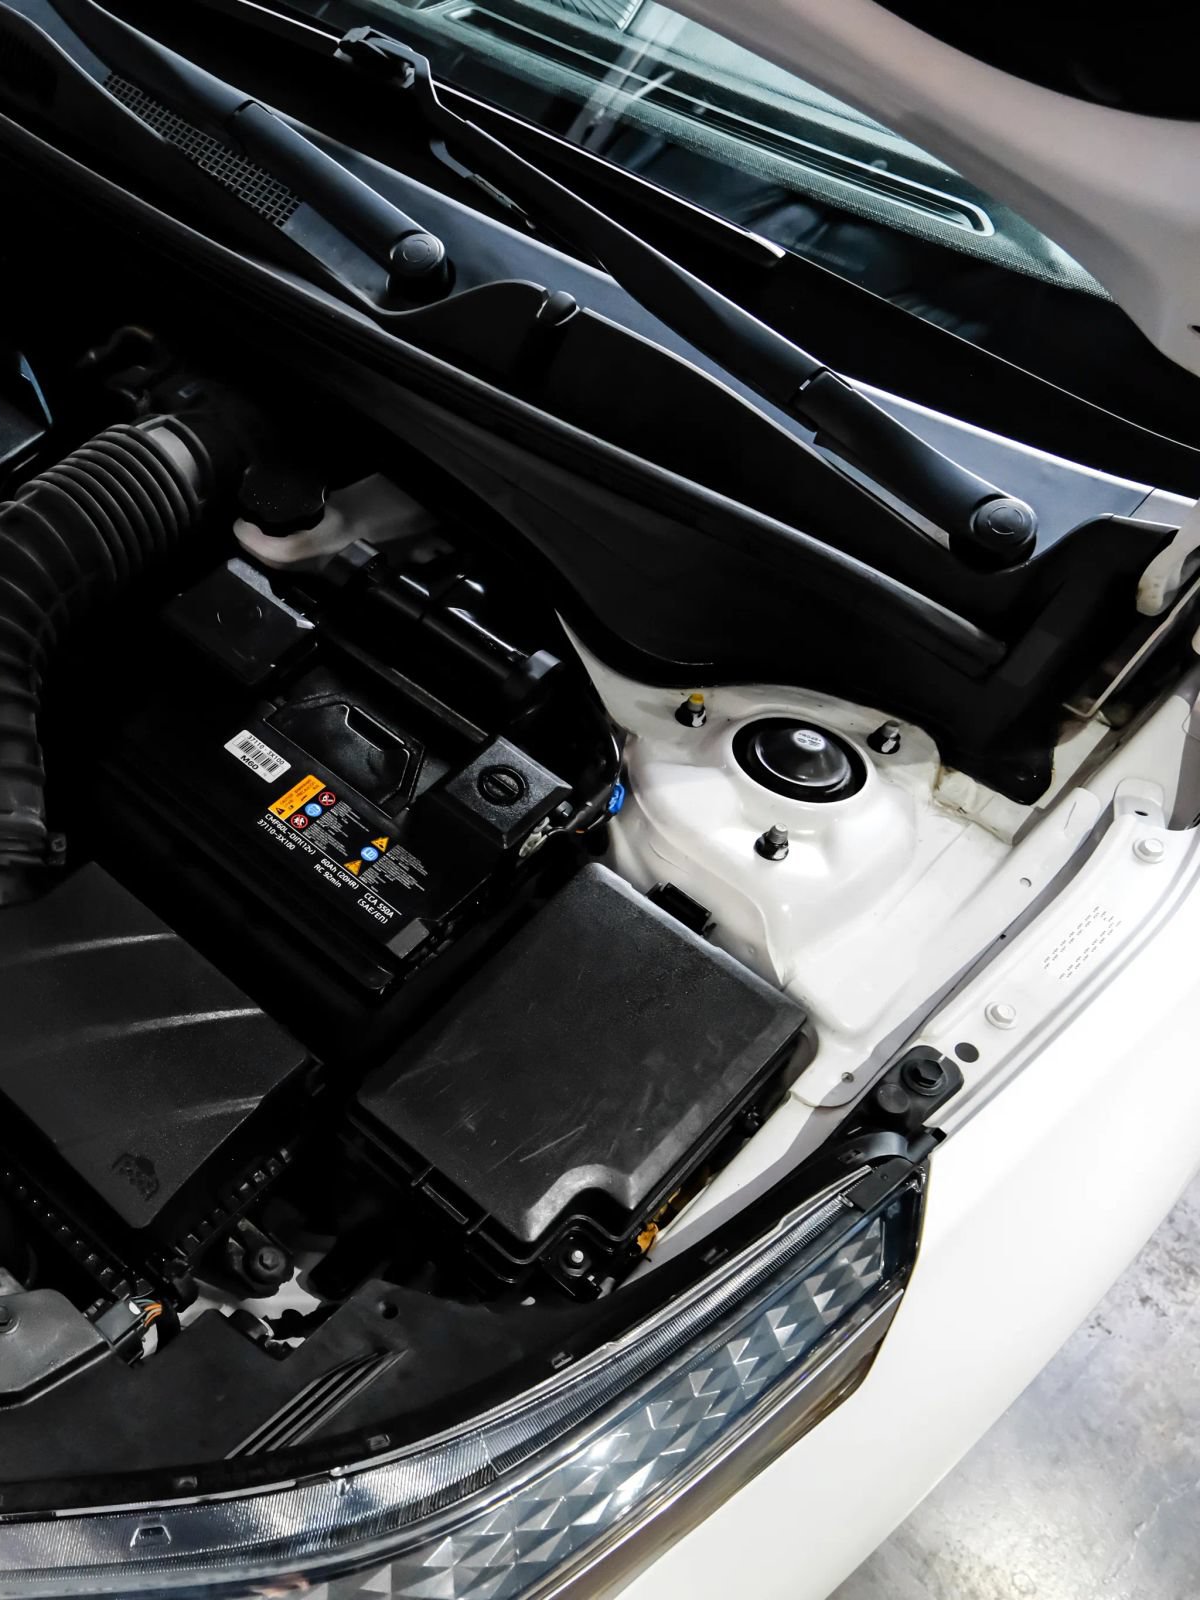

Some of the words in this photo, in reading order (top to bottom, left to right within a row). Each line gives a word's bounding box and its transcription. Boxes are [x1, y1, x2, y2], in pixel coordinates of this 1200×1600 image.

[257, 819, 296, 850] 37110-3X100
[314, 864, 325, 873] RC
[323, 872, 342, 888] 92min
[321, 859, 337, 873] 60Ah
[337, 871, 359, 890] (20HR)
[364, 893, 378, 905] CCA
[377, 903, 394, 918] 550A
